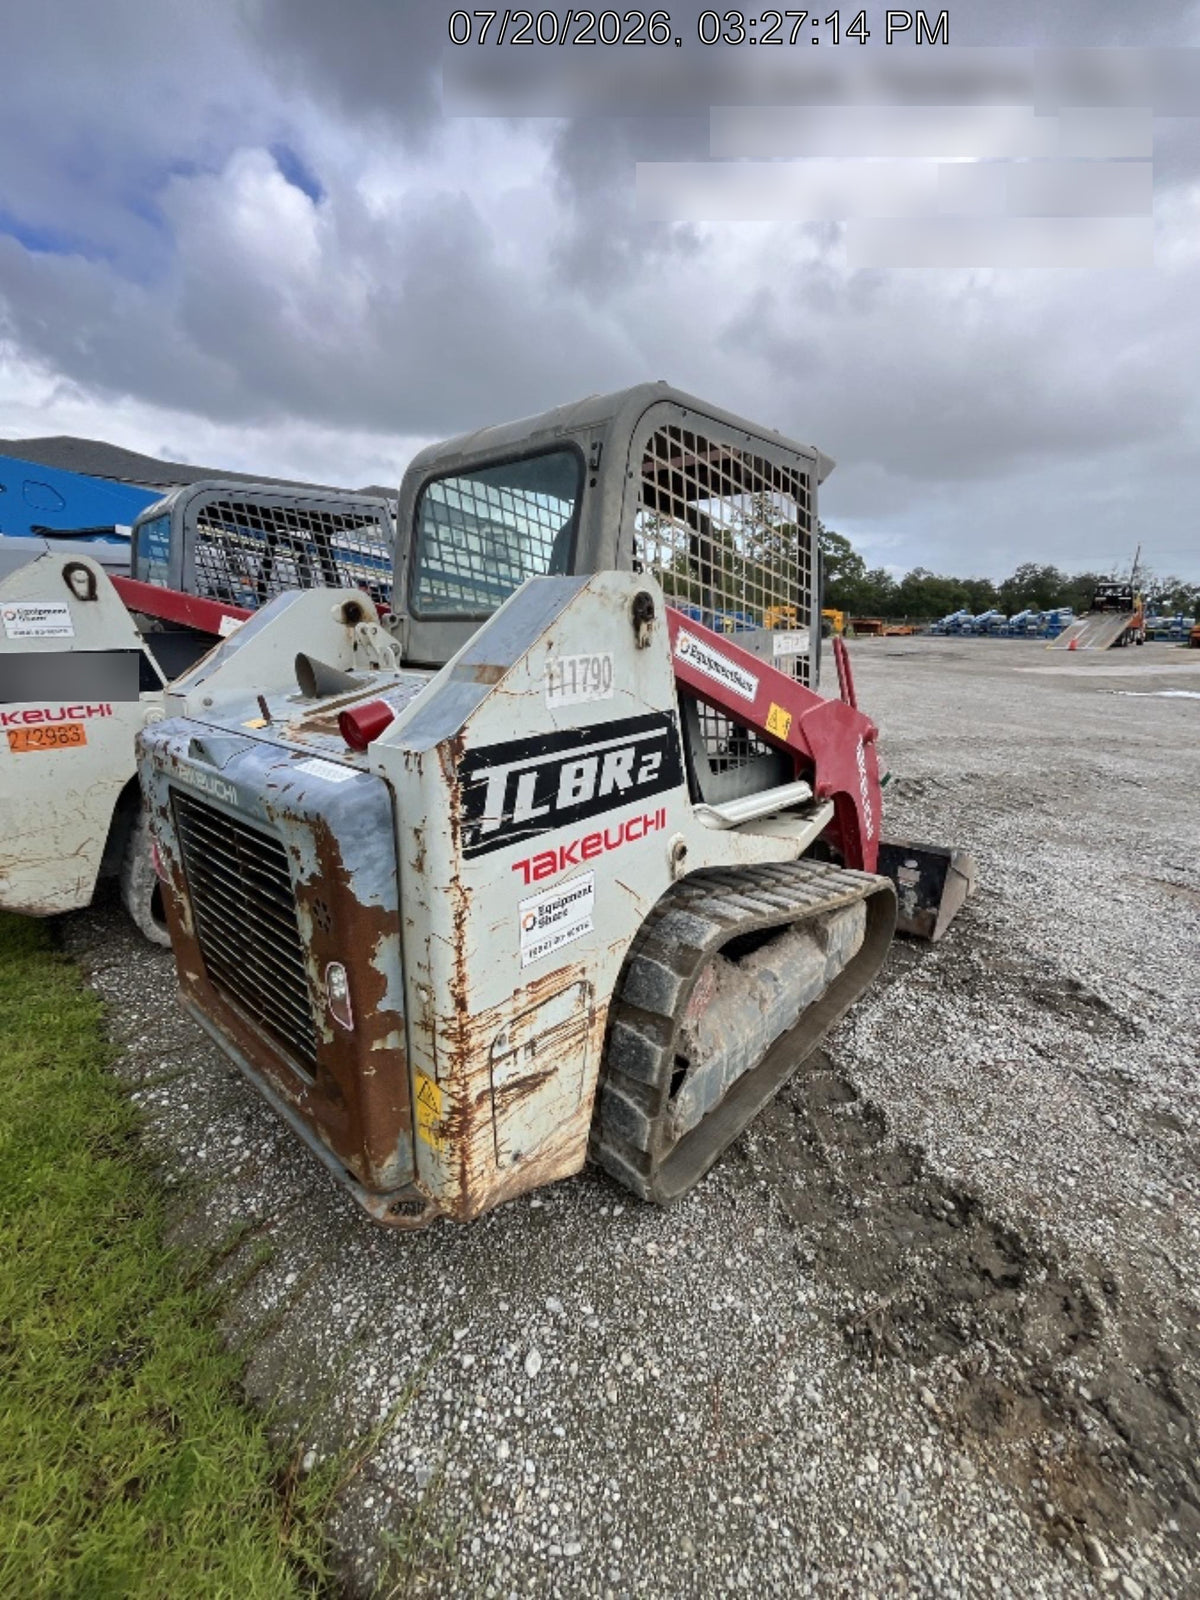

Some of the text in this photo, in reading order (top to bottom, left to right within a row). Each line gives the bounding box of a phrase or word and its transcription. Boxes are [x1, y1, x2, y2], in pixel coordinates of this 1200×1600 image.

[512, 808, 666, 885] TAKEUCHI
[538, 884, 593, 916] Equipment
[538, 908, 569, 929] Share
